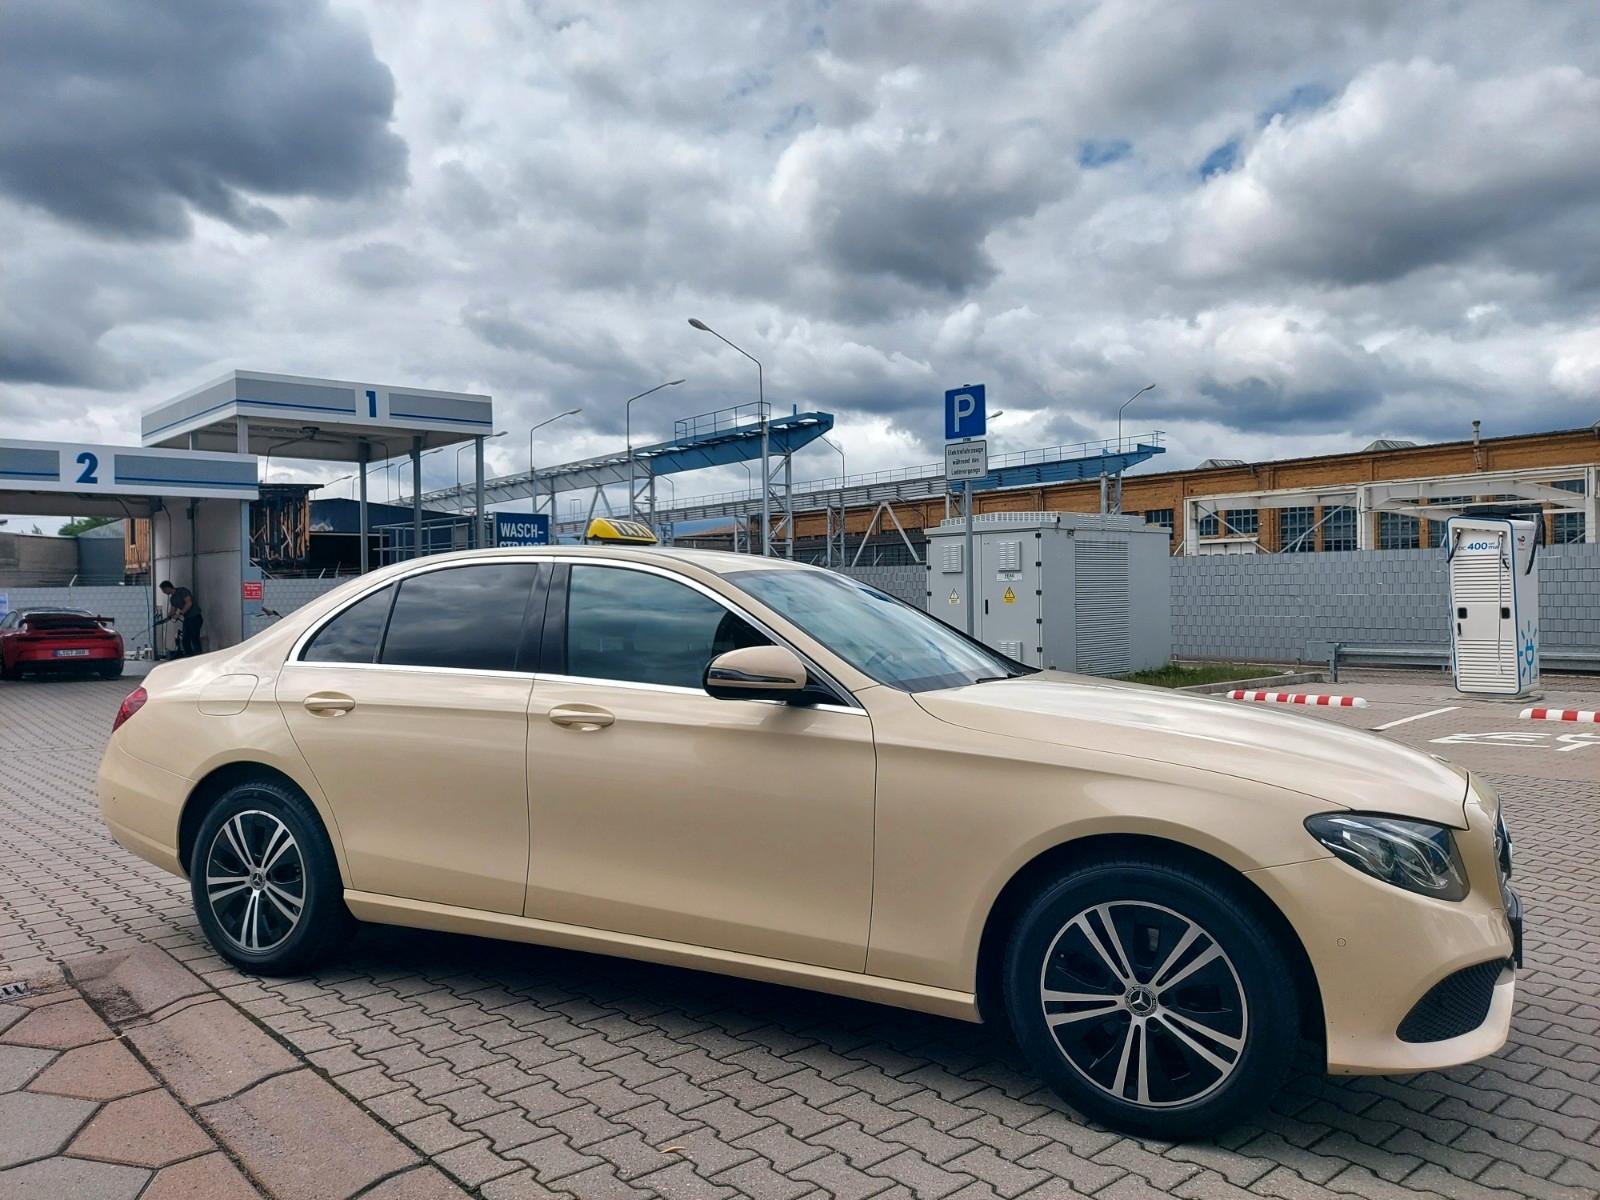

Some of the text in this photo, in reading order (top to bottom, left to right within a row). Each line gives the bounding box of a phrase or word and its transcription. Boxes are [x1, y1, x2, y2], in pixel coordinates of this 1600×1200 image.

[365, 390, 377, 418] 1
[954, 394, 975, 432] P
[76, 452, 98, 484] 2
[500, 522, 544, 538] WASCH-
[609, 521, 655, 538] TAXI
[1467, 542, 1488, 550] 400
